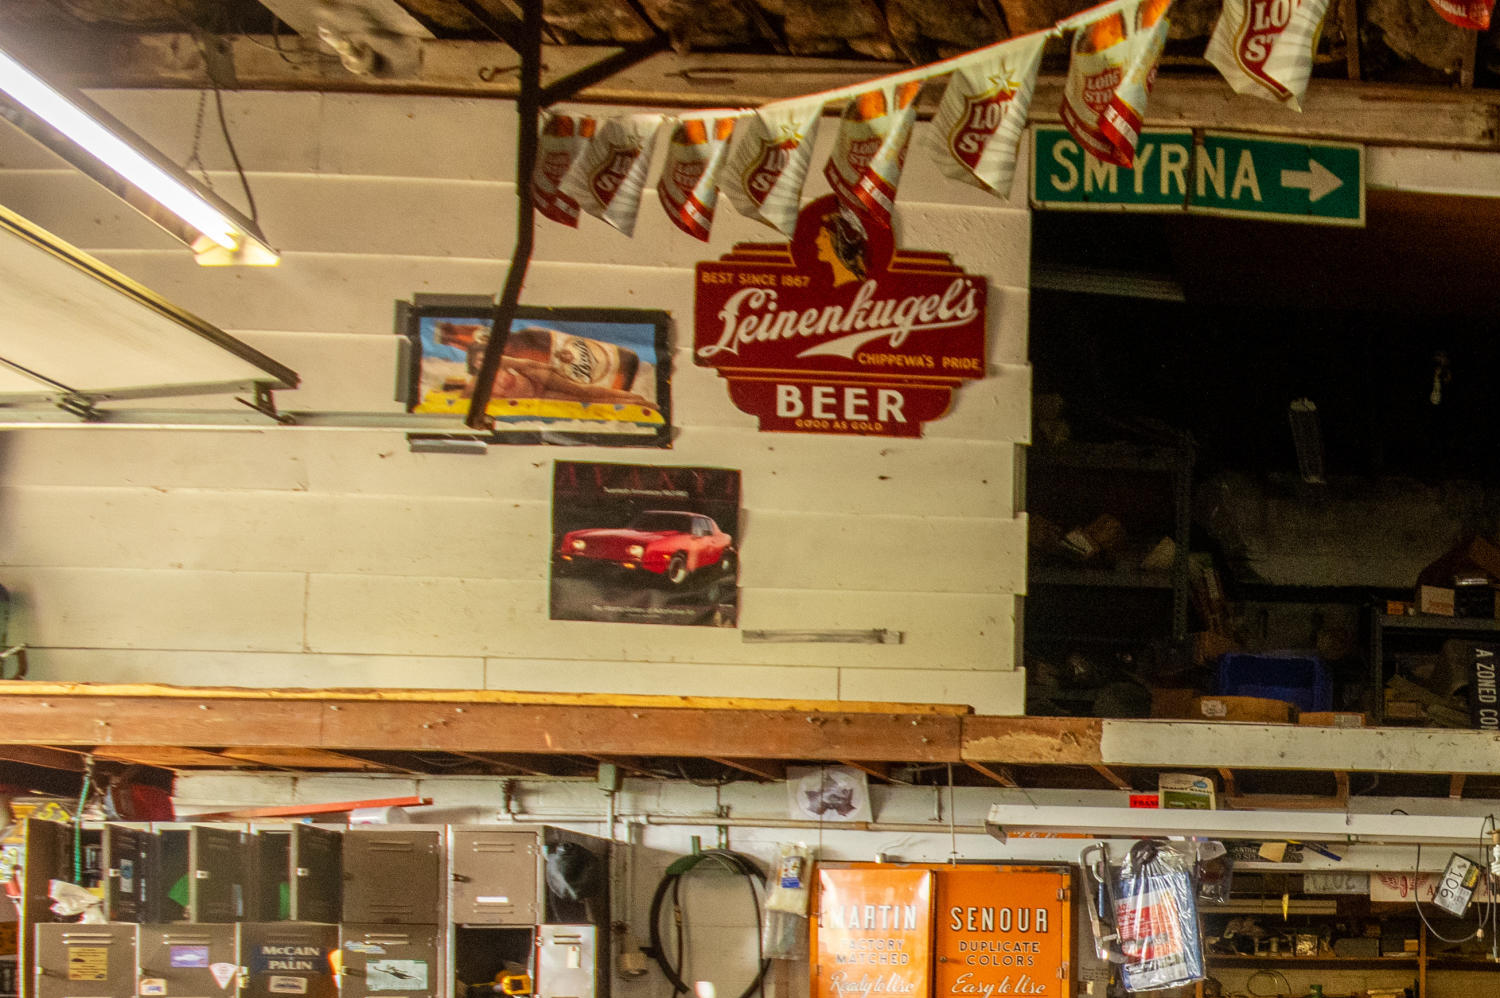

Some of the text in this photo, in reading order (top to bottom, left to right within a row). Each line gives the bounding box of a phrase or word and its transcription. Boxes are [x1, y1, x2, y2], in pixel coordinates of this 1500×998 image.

[1050, 139, 1262, 201] SMYRNA
[702, 272, 734, 285] BEST
[739, 274, 777, 287] SINCE
[697, 279, 979, 358] Leinenkugel's
[857, 352, 980, 371] CHIPPEWA'S PRIDE
[776, 384, 907, 424] BEER
[1475, 648, 1494, 659] A
[1476, 662, 1497, 704] ZONED
[828, 904, 917, 931] MARTIN
[950, 906, 1048, 933] SENOUR
[839, 938, 905, 951] FACTORY
[959, 941, 1040, 954] DUPLICATE
[268, 960, 313, 971] PALIN
[836, 952, 910, 966] MATCHED
[966, 954, 1035, 967] COLORS
[874, 975, 887, 993] to
[886, 971, 915, 993] Use
[998, 974, 1011, 994] to
[1014, 973, 1047, 995] Use
